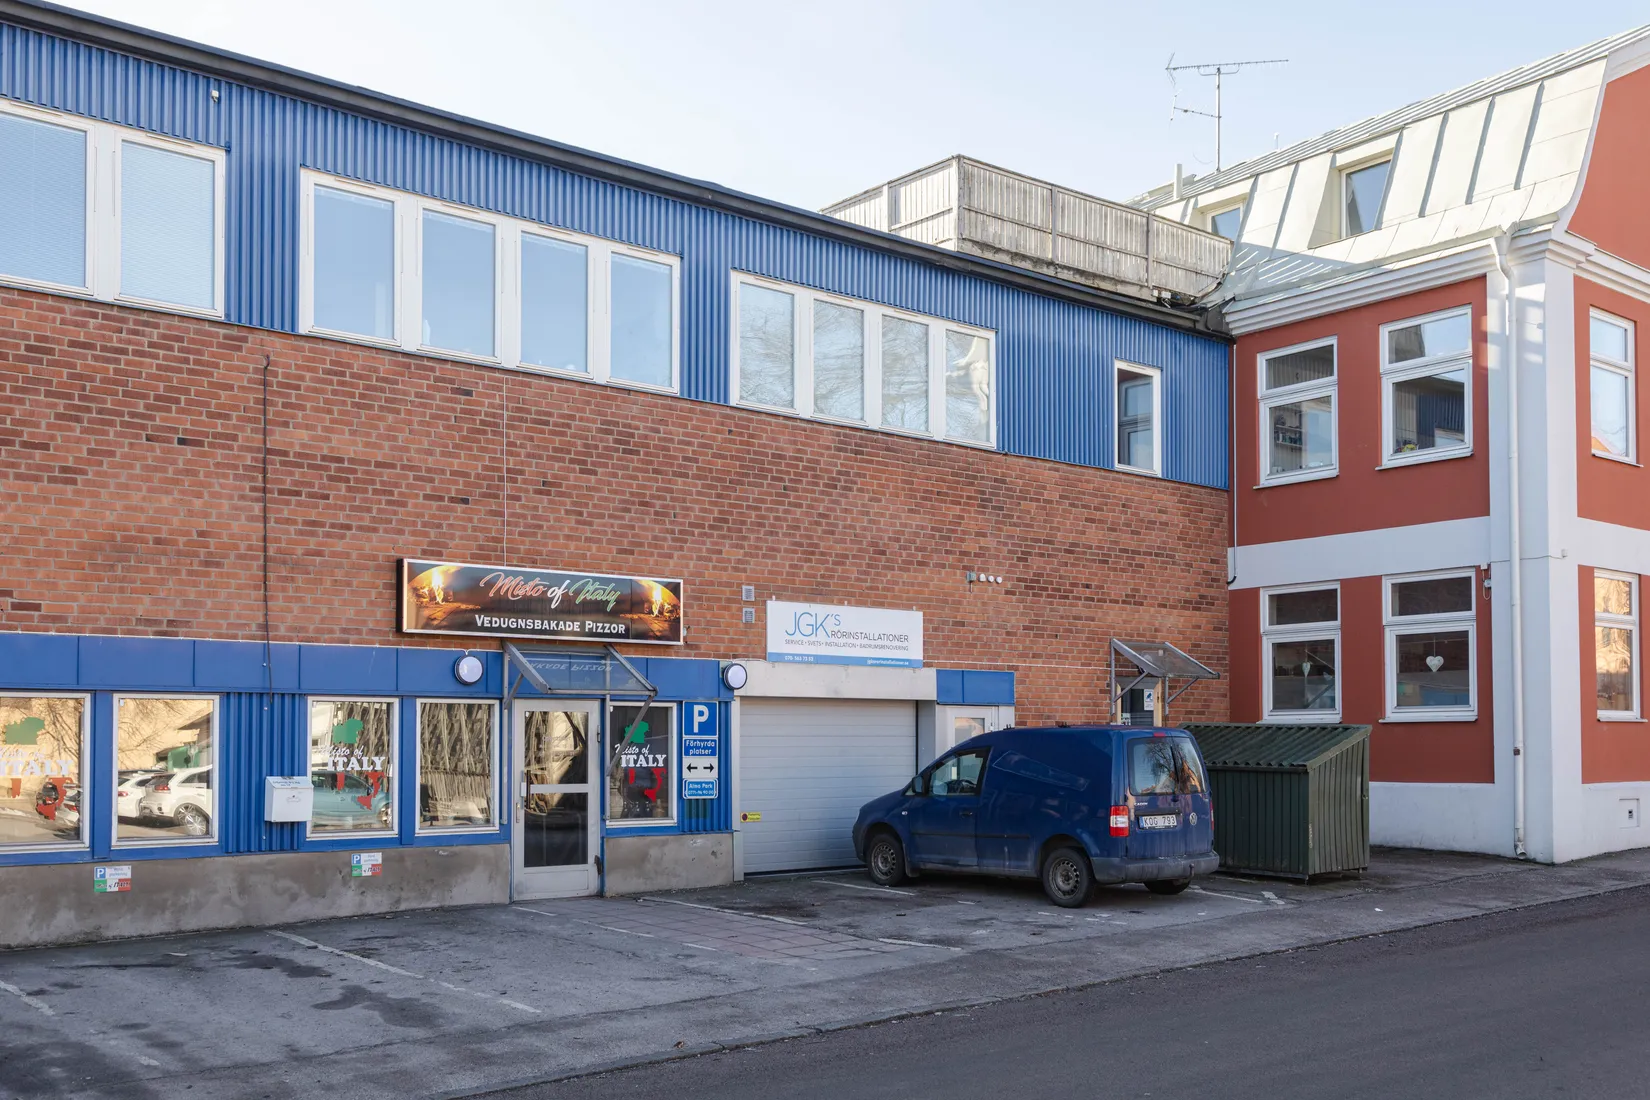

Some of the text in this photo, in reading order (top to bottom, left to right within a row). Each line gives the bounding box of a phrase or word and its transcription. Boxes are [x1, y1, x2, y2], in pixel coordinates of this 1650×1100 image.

[479, 571, 621, 612] Misto of Italy
[824, 641, 857, 649] INSTALLATION
[693, 704, 710, 733] P
[641, 743, 651, 757] of
[685, 740, 716, 748] Förhyrda
[353, 745, 365, 759] of
[689, 748, 712, 756] platser
[326, 756, 386, 771] ITALY
[620, 754, 667, 768] ITALY
[1161, 815, 1176, 825] 793
[352, 855, 361, 864] P
[96, 868, 105, 879] P
